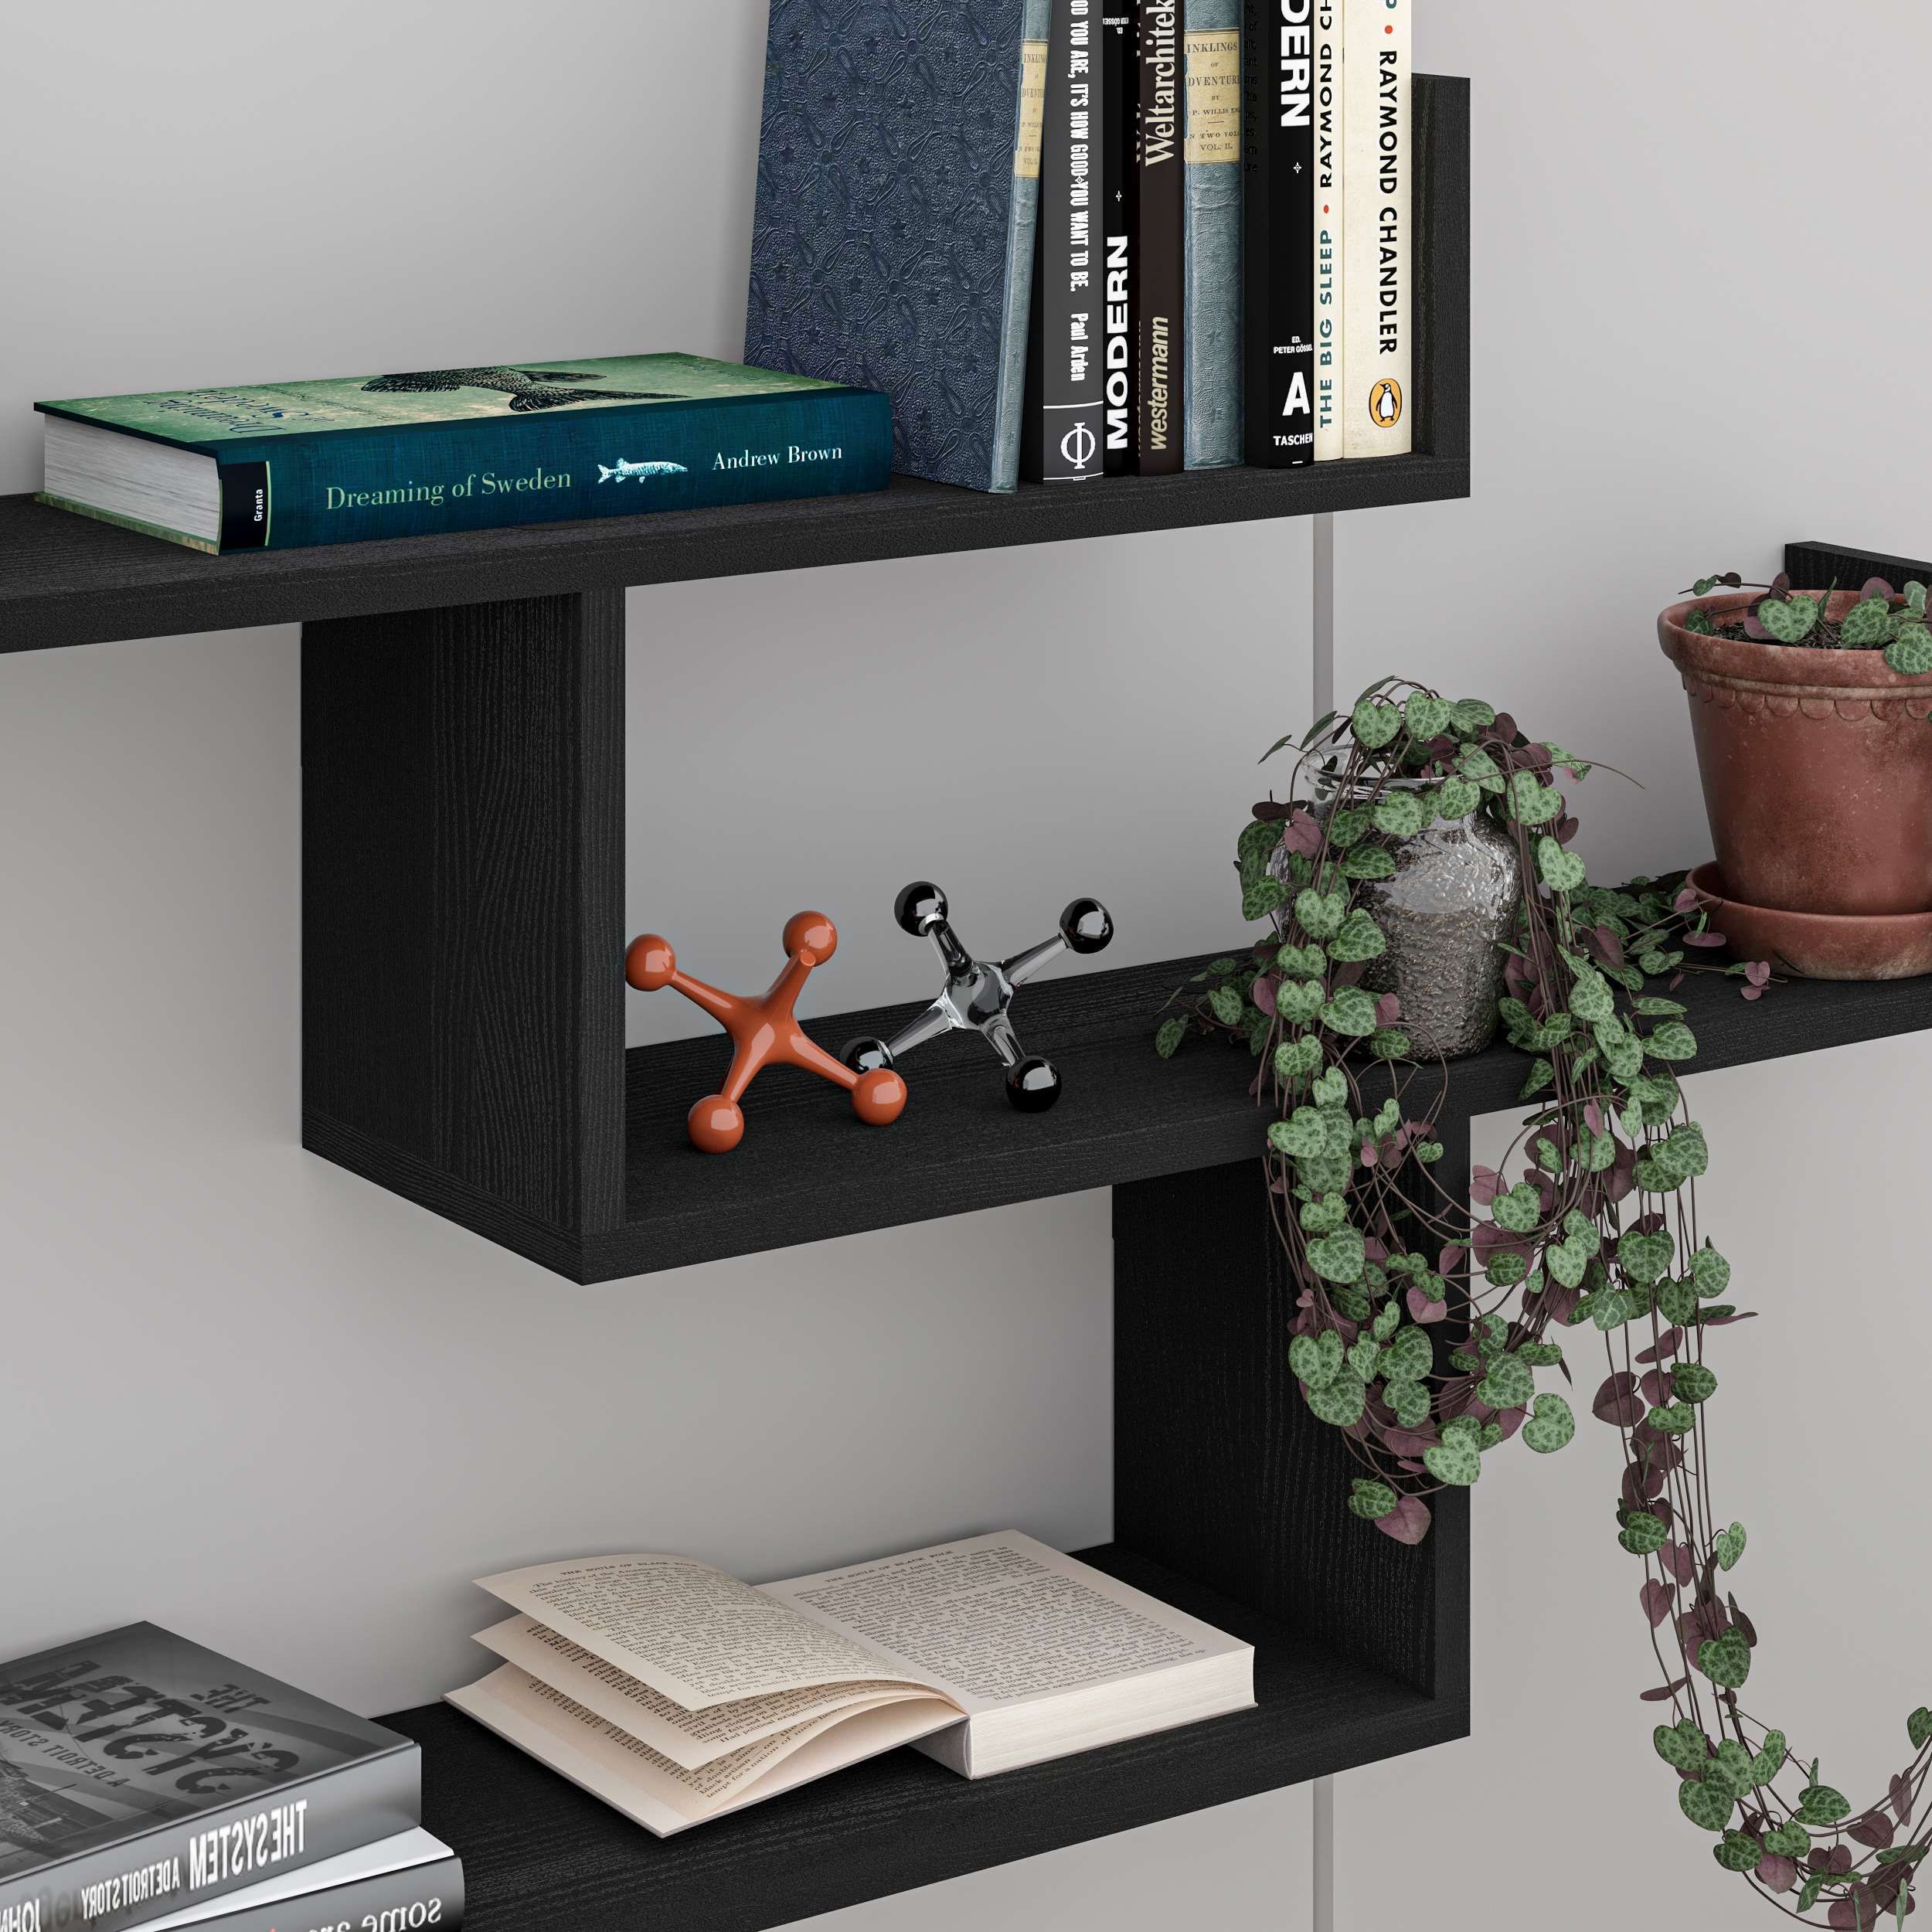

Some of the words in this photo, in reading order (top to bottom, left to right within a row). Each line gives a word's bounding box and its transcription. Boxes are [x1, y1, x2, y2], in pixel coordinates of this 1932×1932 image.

[1070, 21, 1088, 45] YOU
[1186, 42, 1237, 53] INKLINGS
[1068, 50, 1088, 78] ARE,
[1070, 83, 1088, 107] IT'S
[1188, 75, 1240, 87] DVENTUR
[1070, 111, 1088, 139] HOW
[1319, 43, 1332, 188] RAYMOND
[1379, 50, 1397, 193] RAYMOND
[1070, 144, 1088, 176] GOOD
[1070, 181, 1088, 206] YOU
[1070, 210, 1088, 246] WANT
[1070, 250, 1088, 267] TO
[1319, 230, 1332, 305] SLEEP
[1070, 271, 1088, 291] BE.
[1379, 206, 1397, 355] CHANDLER
[1070, 312, 1088, 341] Paul
[1106, 235, 1128, 450] MODERN
[1319, 318, 1332, 366] BIG
[1070, 345, 1088, 382] Arden
[1148, 316, 1168, 451] westermann
[1282, 372, 1311, 416] A
[1319, 379, 1332, 428] THE
[1274, 433, 1313, 446] TASCHEN
[712, 449, 781, 470] Andrew
[787, 445, 842, 464] Brown
[253, 488, 264, 522] Granta
[325, 480, 444, 510] Dreaming
[451, 474, 478, 497] of
[481, 467, 572, 495] Sweden
